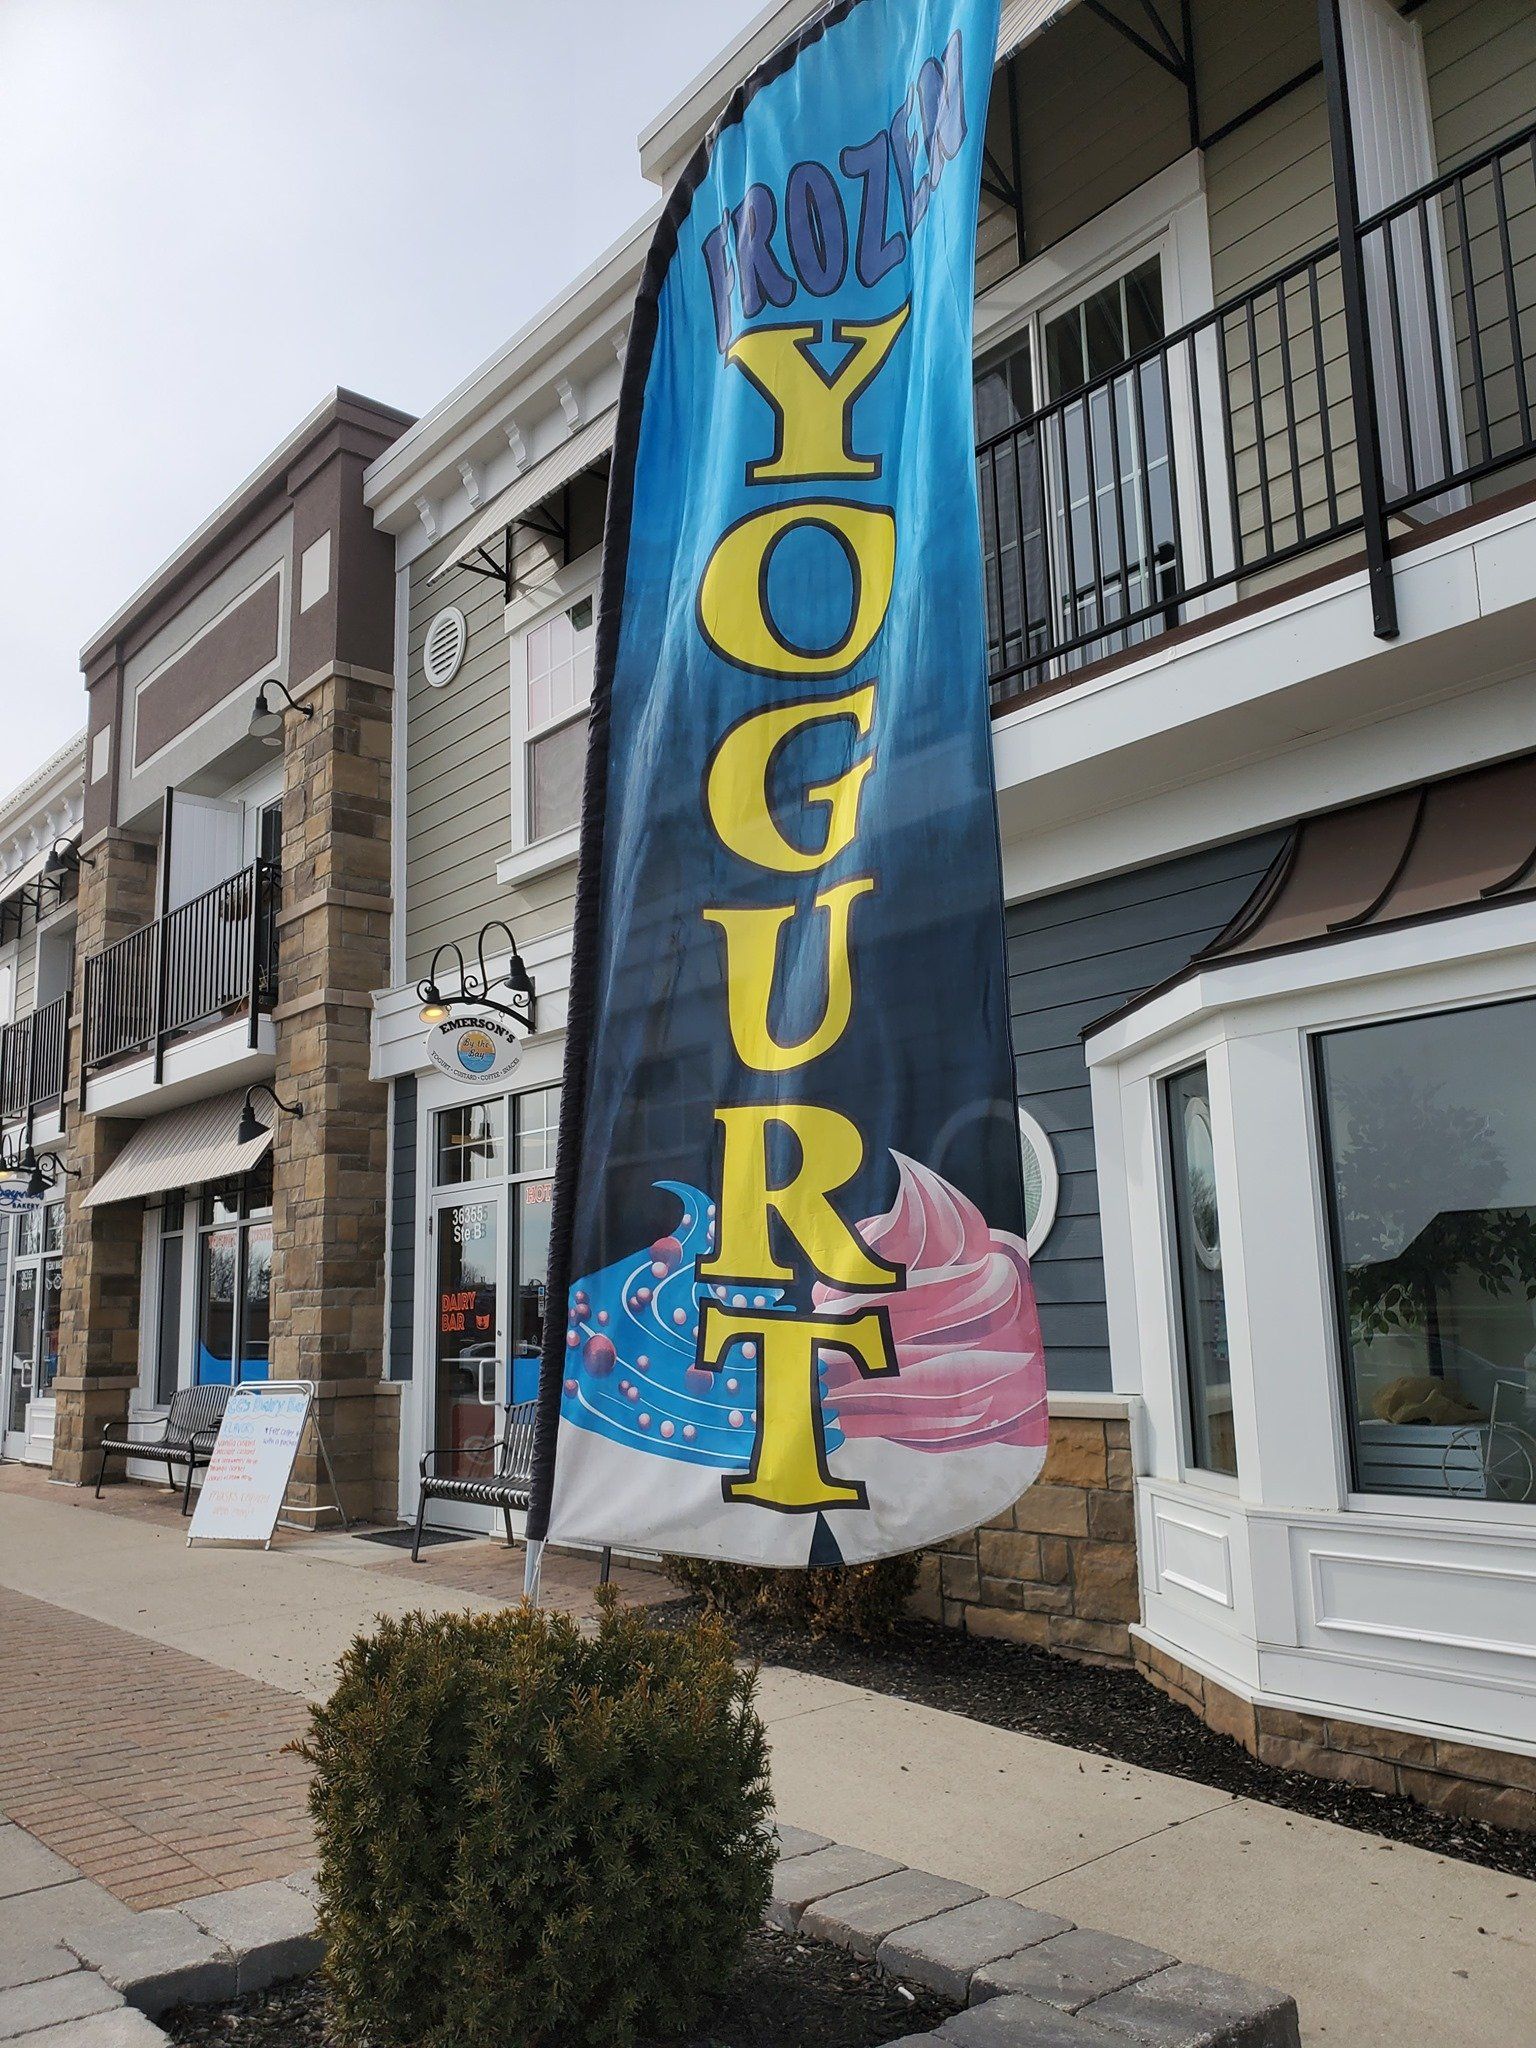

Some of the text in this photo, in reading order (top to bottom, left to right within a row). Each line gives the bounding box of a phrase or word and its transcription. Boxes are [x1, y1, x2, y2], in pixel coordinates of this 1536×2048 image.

[701, 29, 967, 354] FROZEN
[695, 298, 911, 1513] YOGURT
[438, 1017, 516, 1044] EMERSON'S
[431, 1050, 520, 1082] YOGURT CUSTARD COFFEE SNACKS
[12, 1202, 40, 1211] BAKERY
[452, 1205, 483, 1226] 36355
[453, 1223, 482, 1243] Ste B
[442, 1291, 477, 1312] DAIRY
[441, 1313, 465, 1332] BAR
